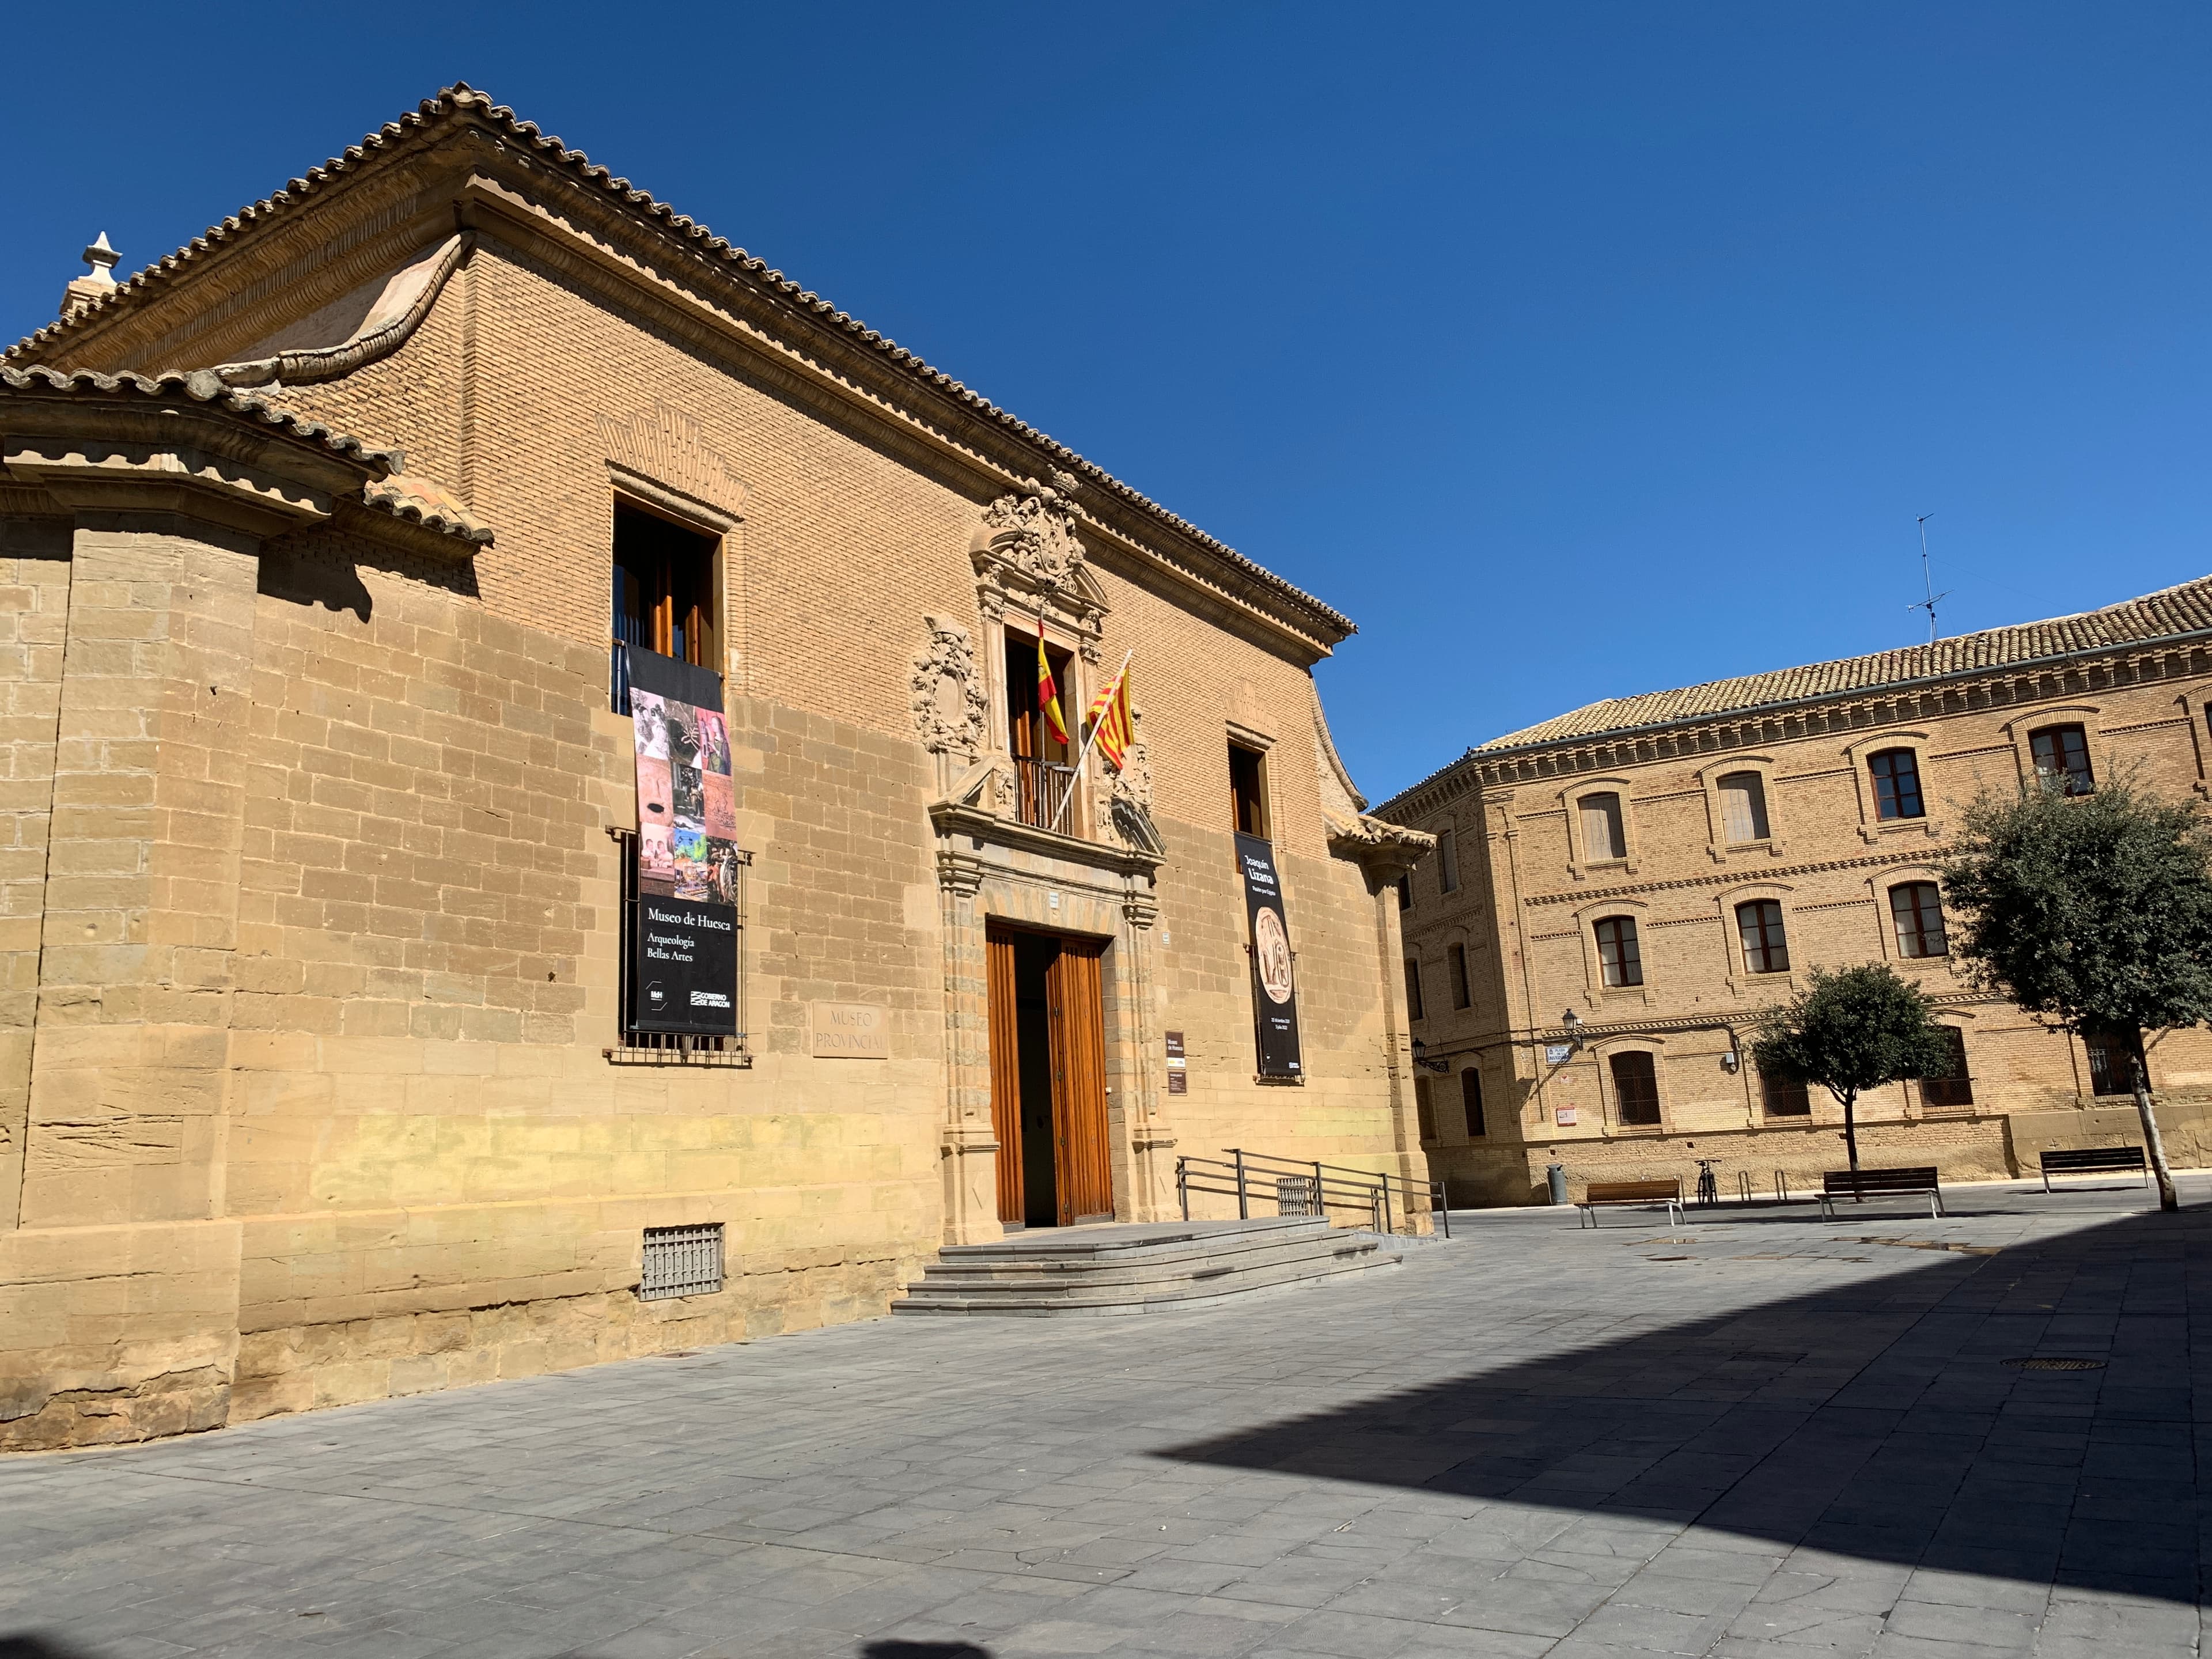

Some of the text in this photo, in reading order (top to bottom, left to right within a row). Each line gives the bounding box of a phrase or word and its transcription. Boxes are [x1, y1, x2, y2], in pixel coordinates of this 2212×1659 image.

[1248, 868, 1274, 885] Lizana
[648, 907, 731, 931] Museo de Huesca
[647, 932, 695, 949] Arqueología
[647, 948, 693, 962] Bellas Artes
[700, 993, 726, 1001] GOBIERNO
[830, 1010, 872, 1027] MUSEO
[816, 1033, 885, 1049] PROVINCIAL
